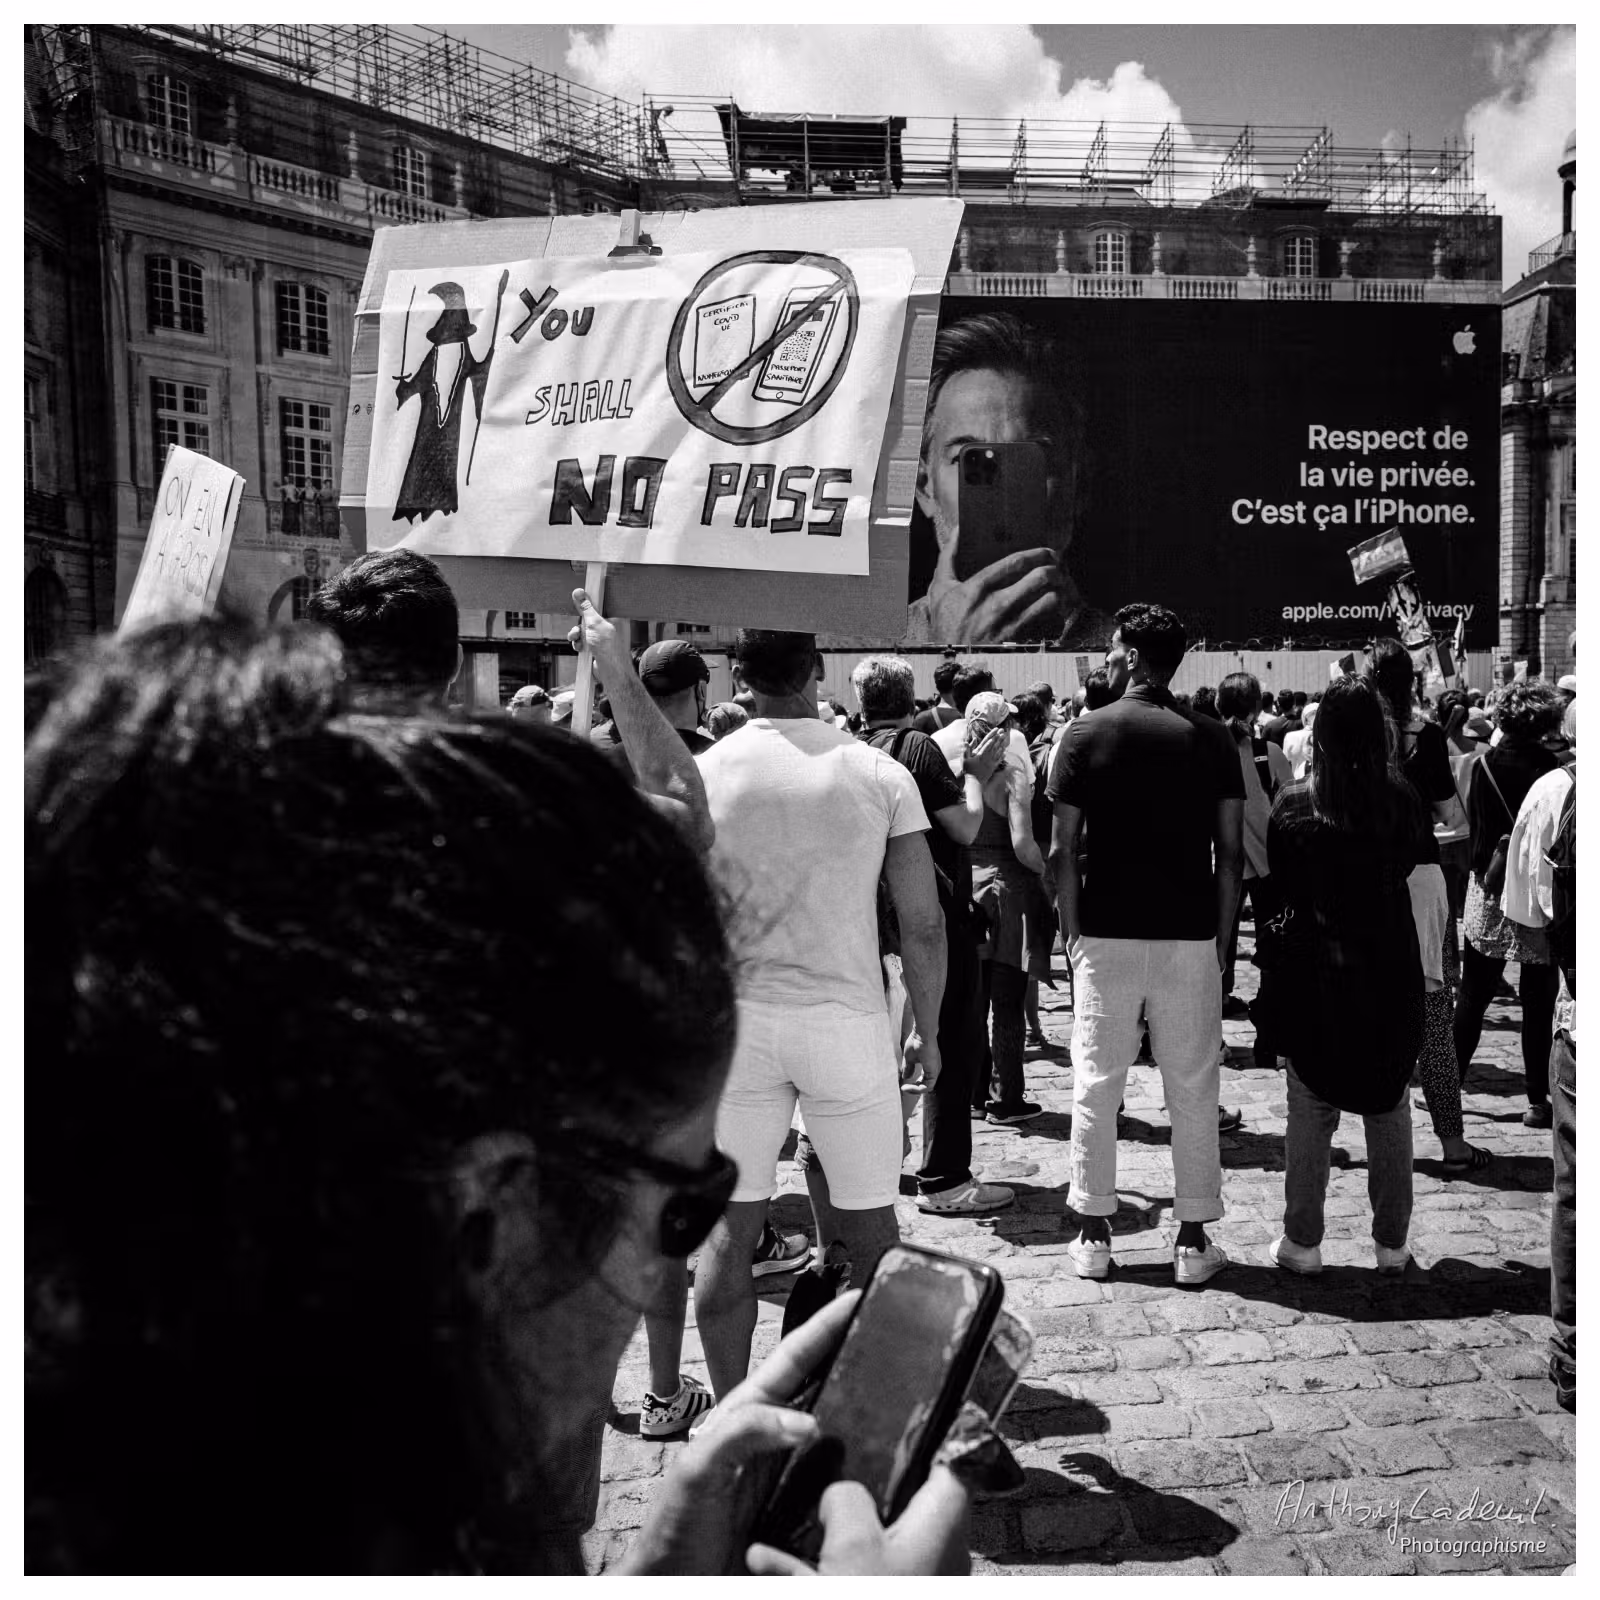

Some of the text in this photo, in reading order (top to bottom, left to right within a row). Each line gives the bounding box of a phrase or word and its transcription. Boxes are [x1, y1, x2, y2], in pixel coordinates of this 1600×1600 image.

[713, 313, 740, 326] COVID
[721, 324, 732, 332] UE
[525, 379, 634, 426] SHALL
[1308, 424, 1468, 455] Respect de
[1300, 460, 1475, 492] la vie privée.
[165, 476, 192, 521] ON
[548, 454, 853, 537] NO PASS
[1231, 498, 1475, 531] C'est ça l'iPhone.
